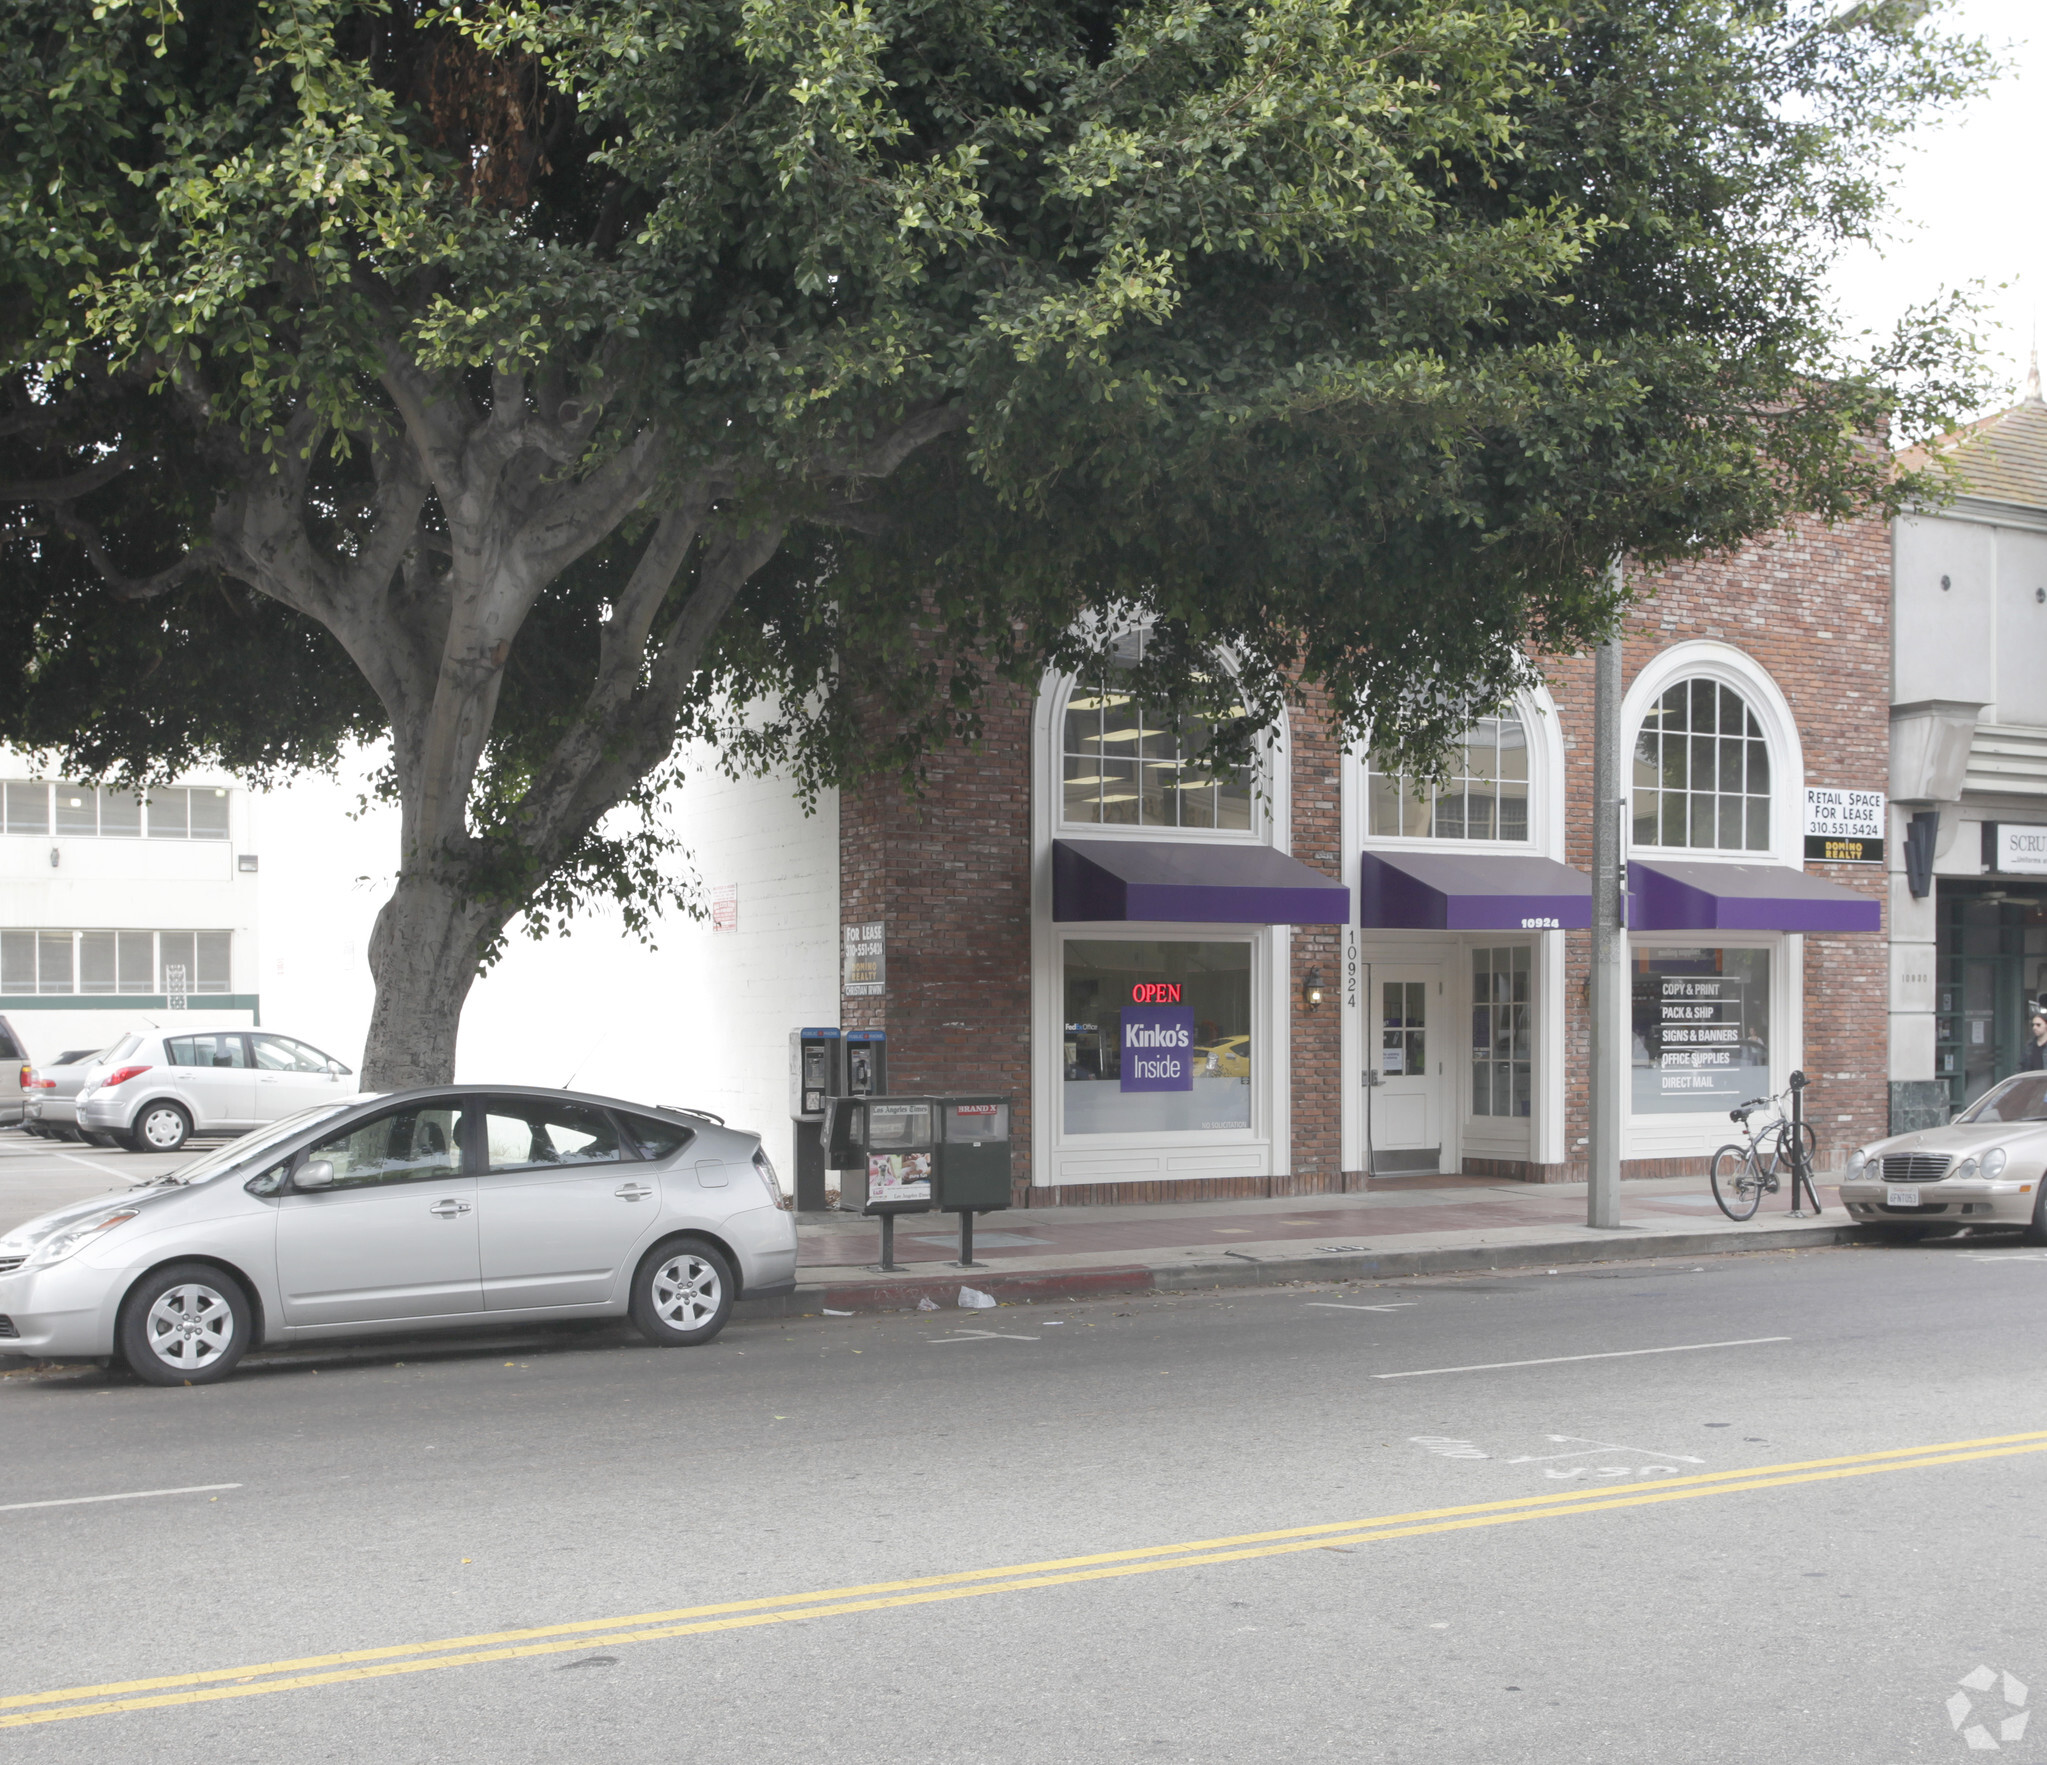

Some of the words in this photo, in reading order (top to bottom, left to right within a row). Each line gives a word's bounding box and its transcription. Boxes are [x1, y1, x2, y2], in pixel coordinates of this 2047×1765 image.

[1808, 790, 1842, 805] RETAIL
[1849, 792, 1880, 807] SPACE
[1815, 805, 1836, 819] FOR
[1843, 806, 1873, 821] LEASE
[1810, 821, 1878, 836] 310.551.5424
[1825, 840, 1863, 851] DOMINO
[2010, 834, 2047, 852] SCRU
[1825, 850, 1862, 859] REALTY
[1521, 917, 1560, 929] 10924
[846, 927, 860, 941] FOR
[862, 925, 882, 941] LEASE
[1347, 930, 1357, 1008] 10924
[851, 971, 877, 981] REALTY
[1132, 983, 1182, 1003] OPEN
[1662, 983, 1686, 995] COPY
[1686, 983, 1694, 995] &
[1695, 983, 1720, 995] PRINT
[1662, 1006, 1684, 1019] PACK
[1685, 1006, 1693, 1018] &
[1694, 1006, 1714, 1018] SHIP
[1126, 1024, 1189, 1048] Kinko's
[1662, 1029, 1689, 1042] SIGNS
[1689, 1029, 1697, 1042] &
[1698, 1029, 1738, 1041] BANNERS
[1662, 1053, 1690, 1065] OFFICE
[1691, 1052, 1730, 1064] SUPPLIES
[1134, 1054, 1181, 1078] Inside
[1662, 1077, 1691, 1088] DIRECT
[1692, 1076, 1714, 1088] MAIL
[885, 1105, 908, 1114] Angeles
[909, 1104, 928, 1113] Times
[958, 1104, 989, 1113] BRAND
[990, 1104, 997, 1112] X
